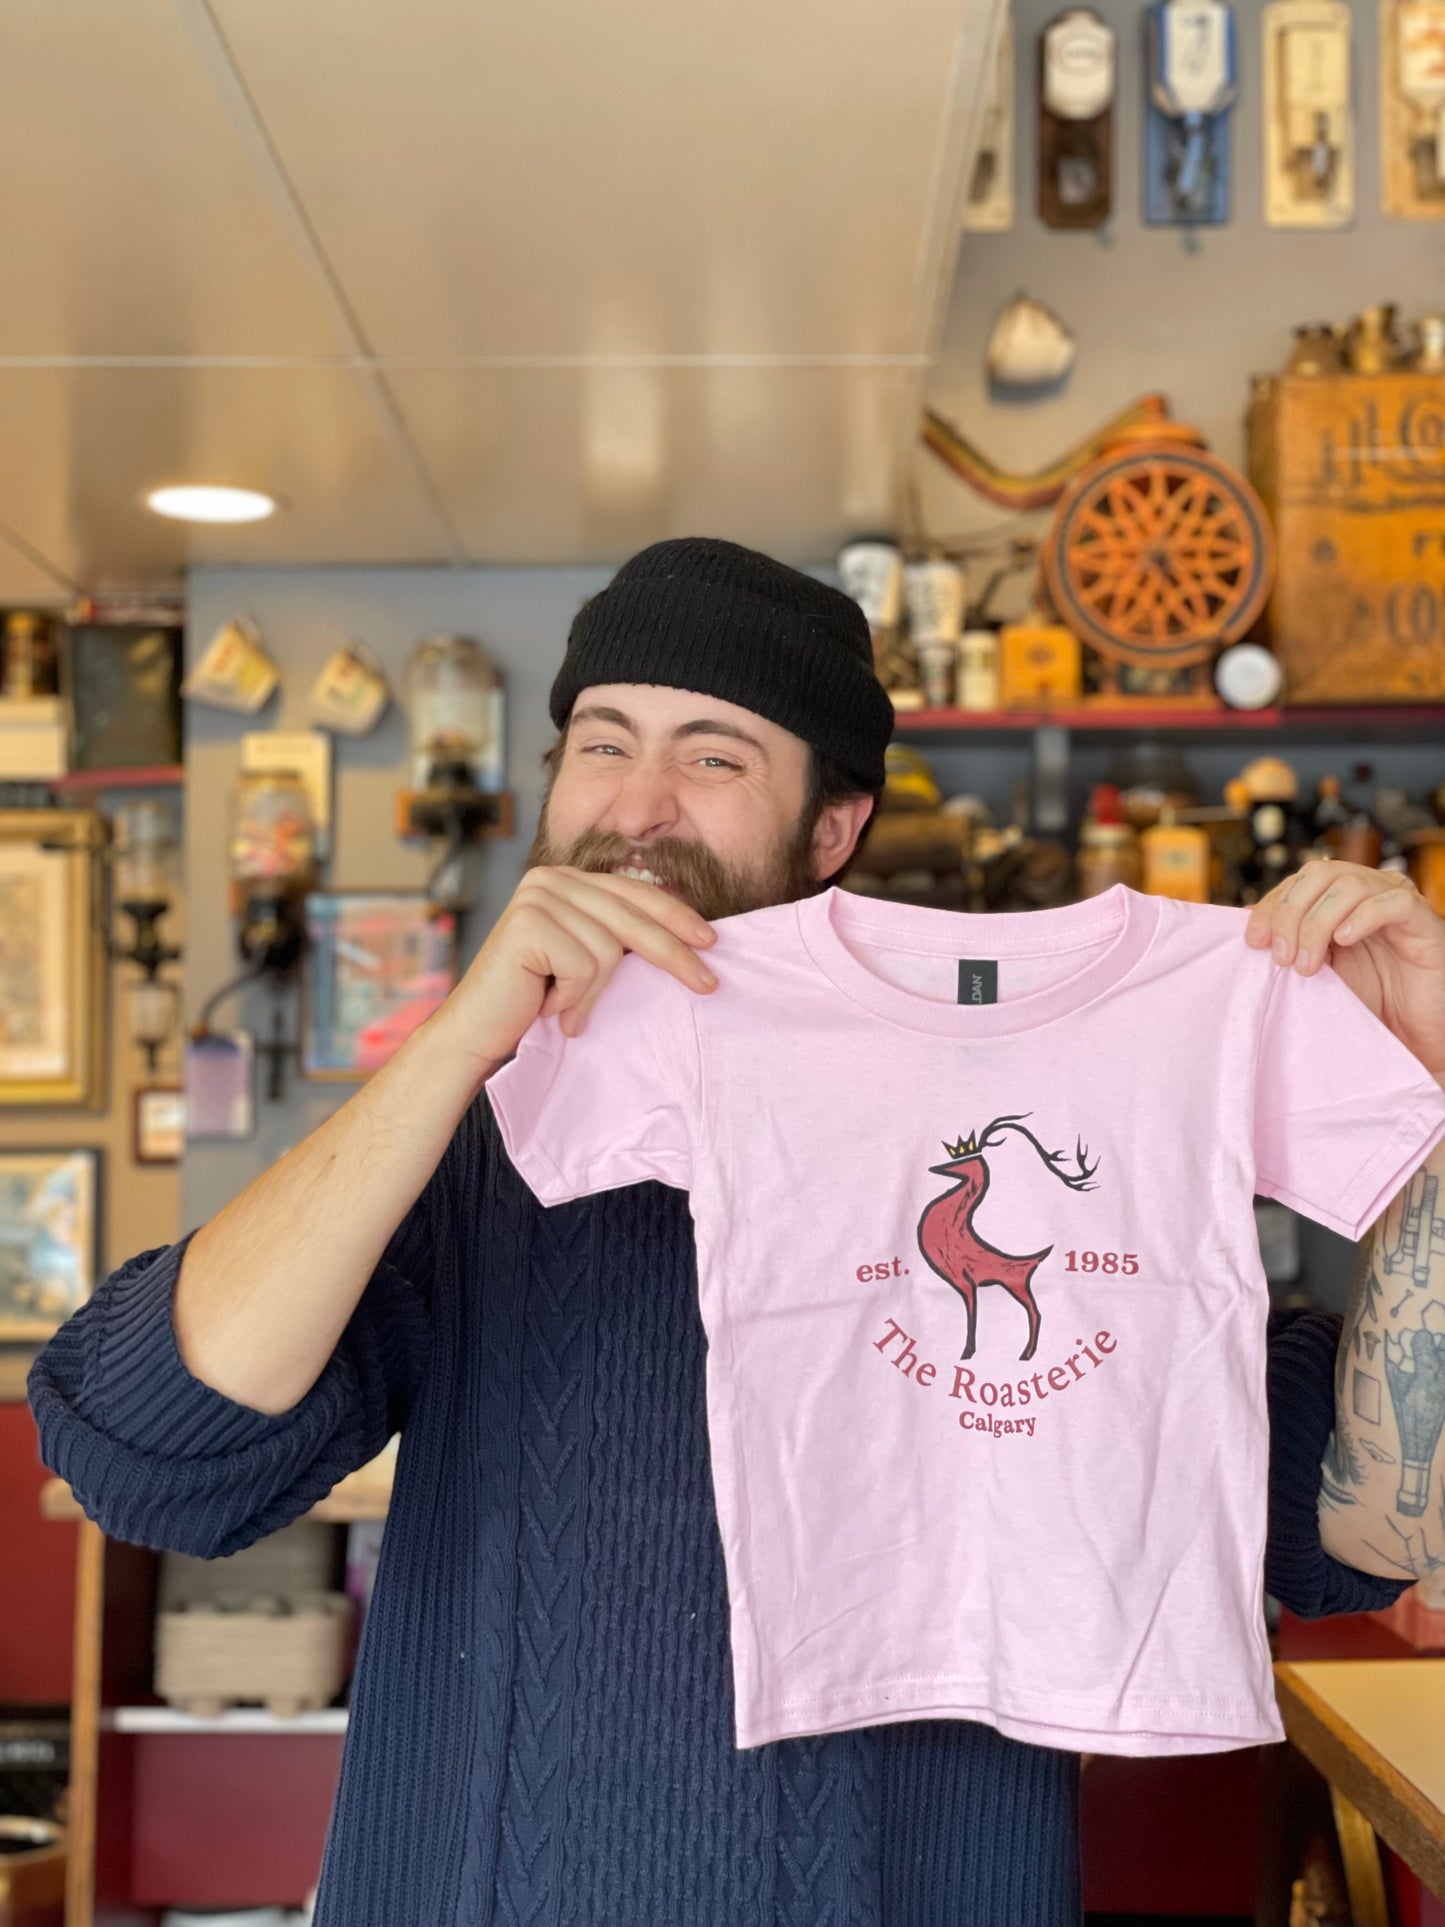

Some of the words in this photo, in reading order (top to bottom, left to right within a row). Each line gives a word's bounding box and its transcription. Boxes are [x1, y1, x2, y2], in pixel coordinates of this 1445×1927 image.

[857, 1256, 909, 1282] est.
[1064, 1250, 1139, 1275] 1985
[873, 1318, 936, 1386] The
[948, 1330, 1118, 1407] Roasterie
[959, 1411, 1036, 1438] Calgary
